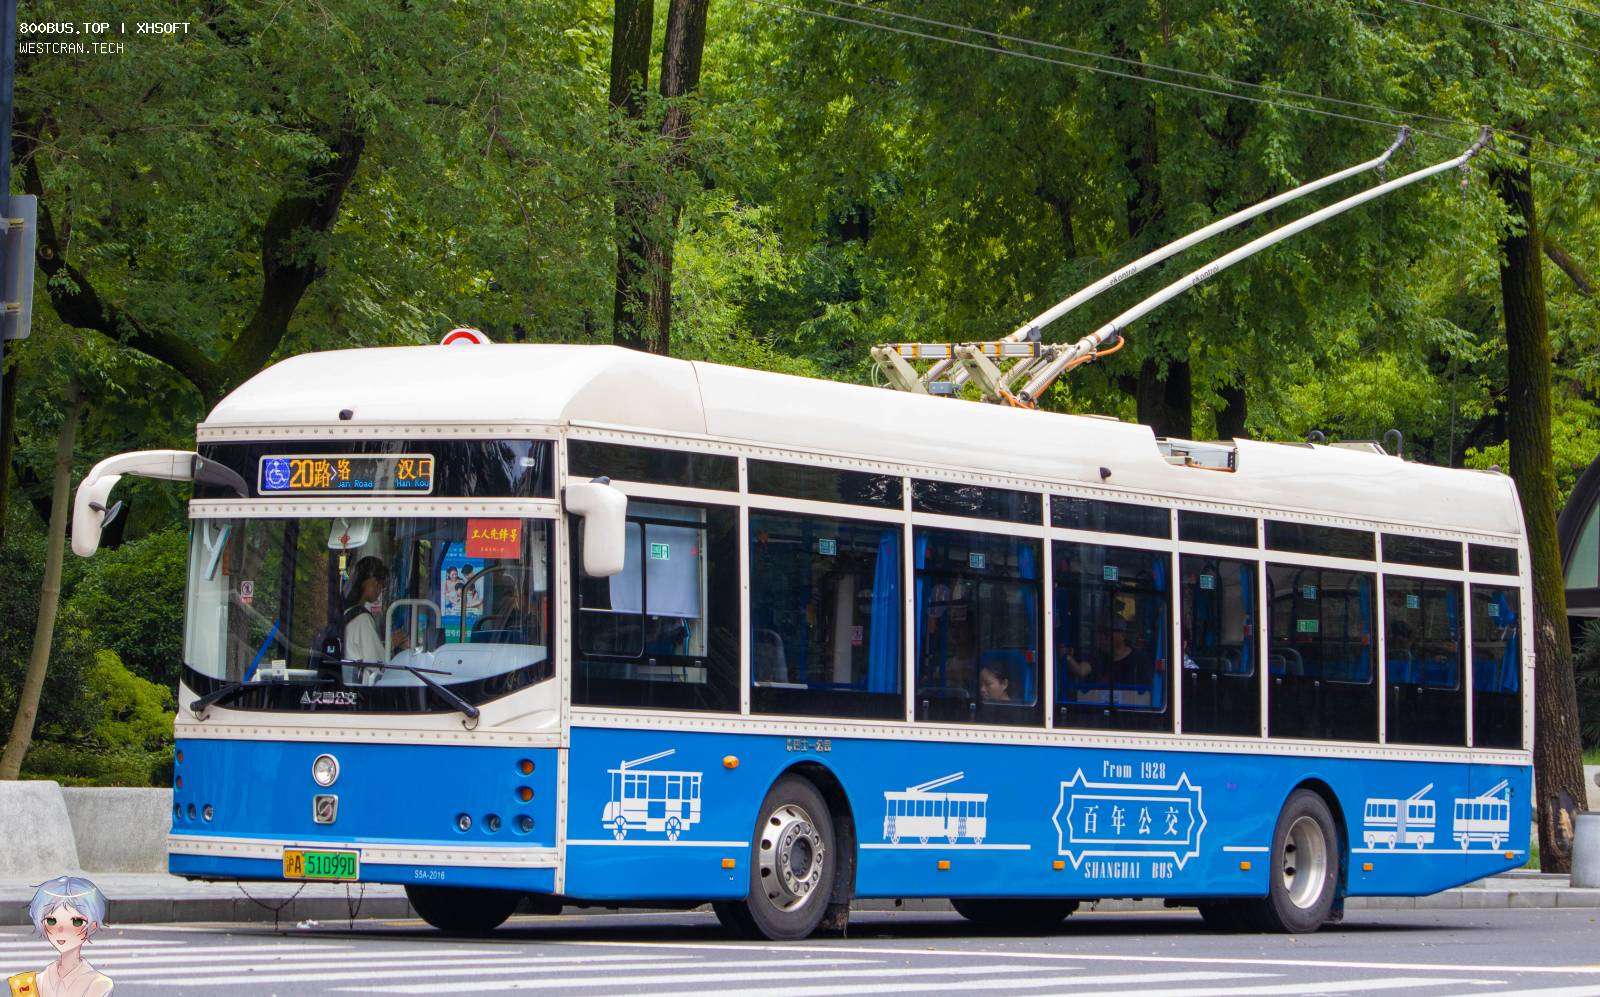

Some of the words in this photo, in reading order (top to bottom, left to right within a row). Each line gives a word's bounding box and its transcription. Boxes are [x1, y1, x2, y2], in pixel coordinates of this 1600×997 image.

[289, 459, 331, 488] 20路
[354, 479, 373, 488] Road
[397, 479, 411, 487] Han
[1103, 760, 1132, 778] From
[1141, 762, 1166, 779] 1928
[1084, 804, 1179, 836] 百年公交
[1085, 861, 1140, 879] SHANGHAI
[1152, 862, 1173, 879] BUS
